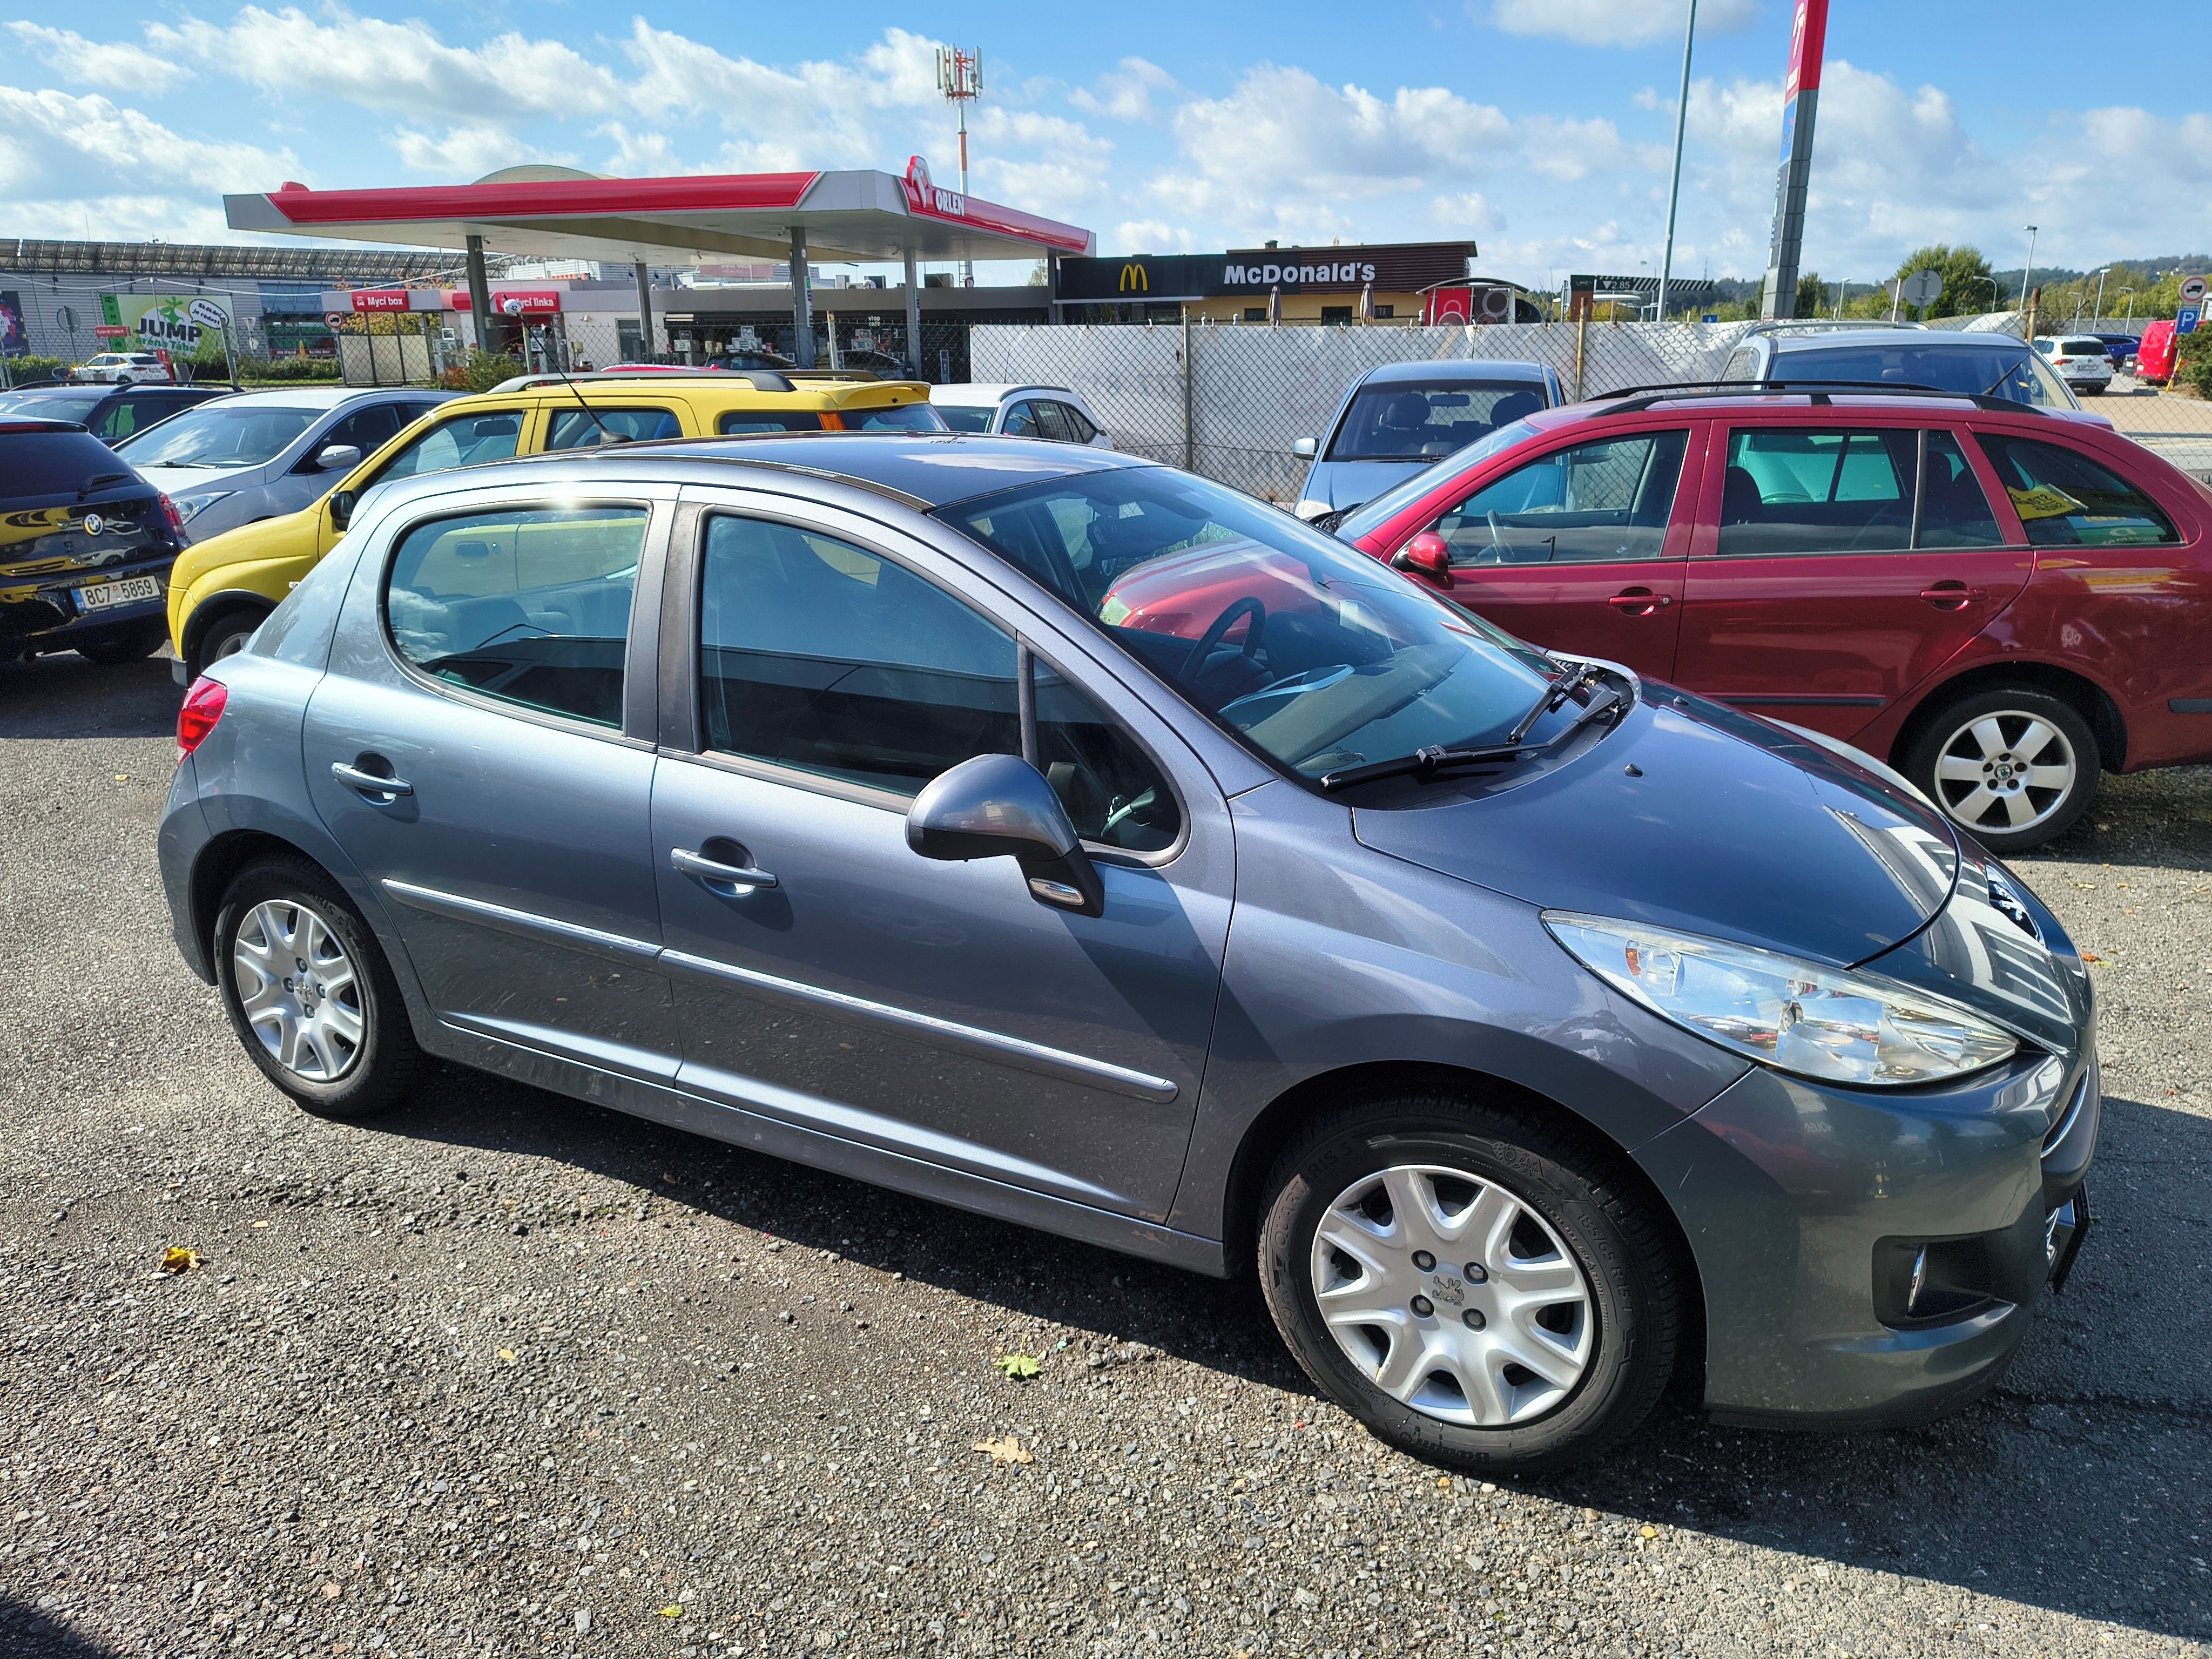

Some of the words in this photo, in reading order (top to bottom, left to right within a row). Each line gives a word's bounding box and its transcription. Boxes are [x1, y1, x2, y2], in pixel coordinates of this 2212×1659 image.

[935, 189, 965, 216] ORLEN
[1224, 262, 1375, 285] McDonald's
[1611, 280, 1630, 289] 2.85
[367, 296, 387, 307] Mycí
[388, 296, 403, 305] box
[533, 297, 554, 306] linka
[2181, 312, 2195, 327] P
[135, 318, 203, 342] JUMP
[85, 586, 110, 605] 8C7
[120, 578, 153, 599] 5859
